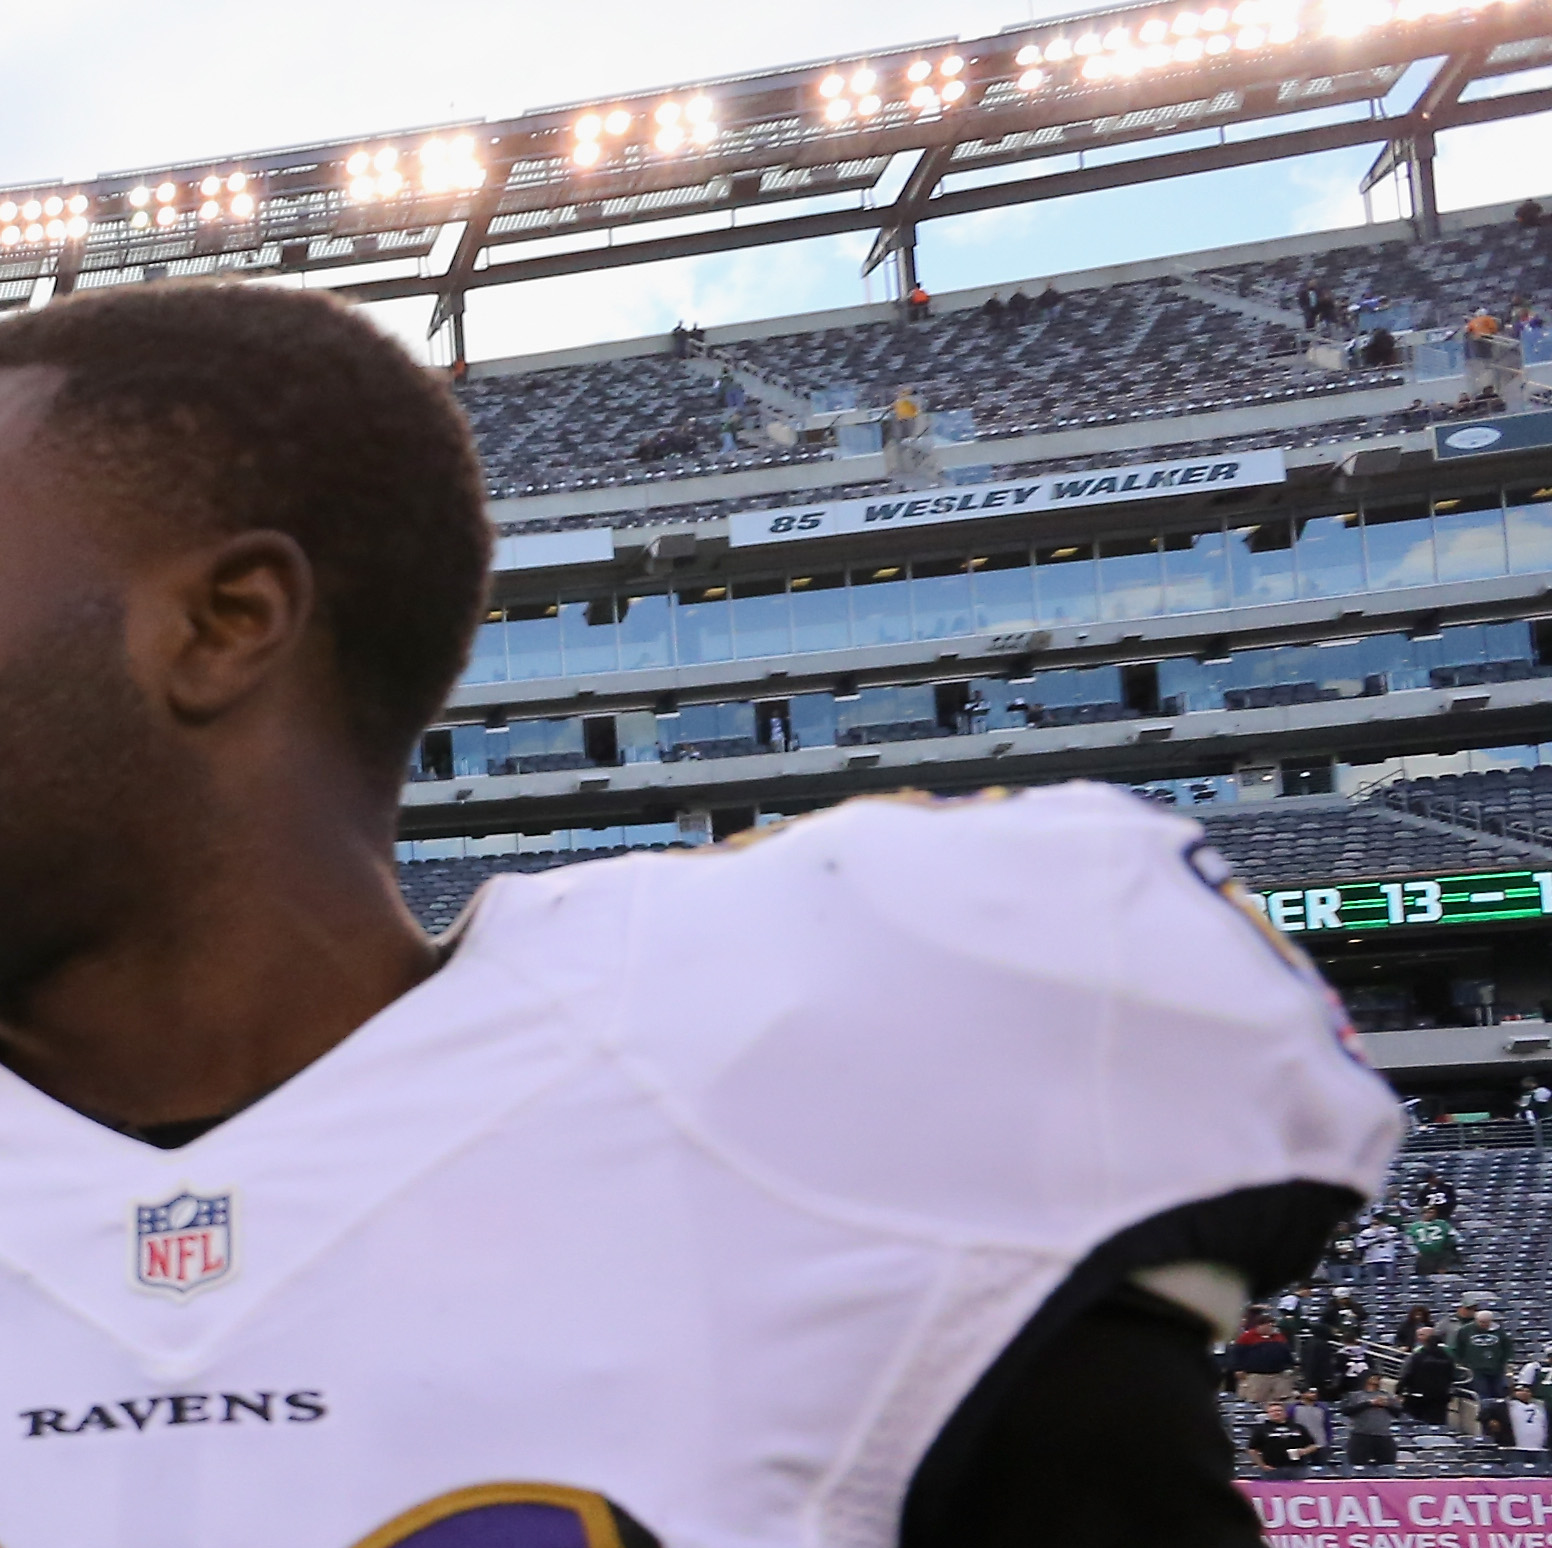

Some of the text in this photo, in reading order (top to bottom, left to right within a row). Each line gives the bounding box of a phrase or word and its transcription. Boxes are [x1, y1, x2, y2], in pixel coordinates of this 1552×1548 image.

[768, 461, 1240, 533] 85 WESLEY WALKER
[1380, 880, 1443, 925] 13
[146, 1232, 225, 1281] NFL
[1415, 1225, 1444, 1242] 12
[19, 1390, 328, 1438] RAVENS
[1252, 1494, 1401, 1528] UCIAL
